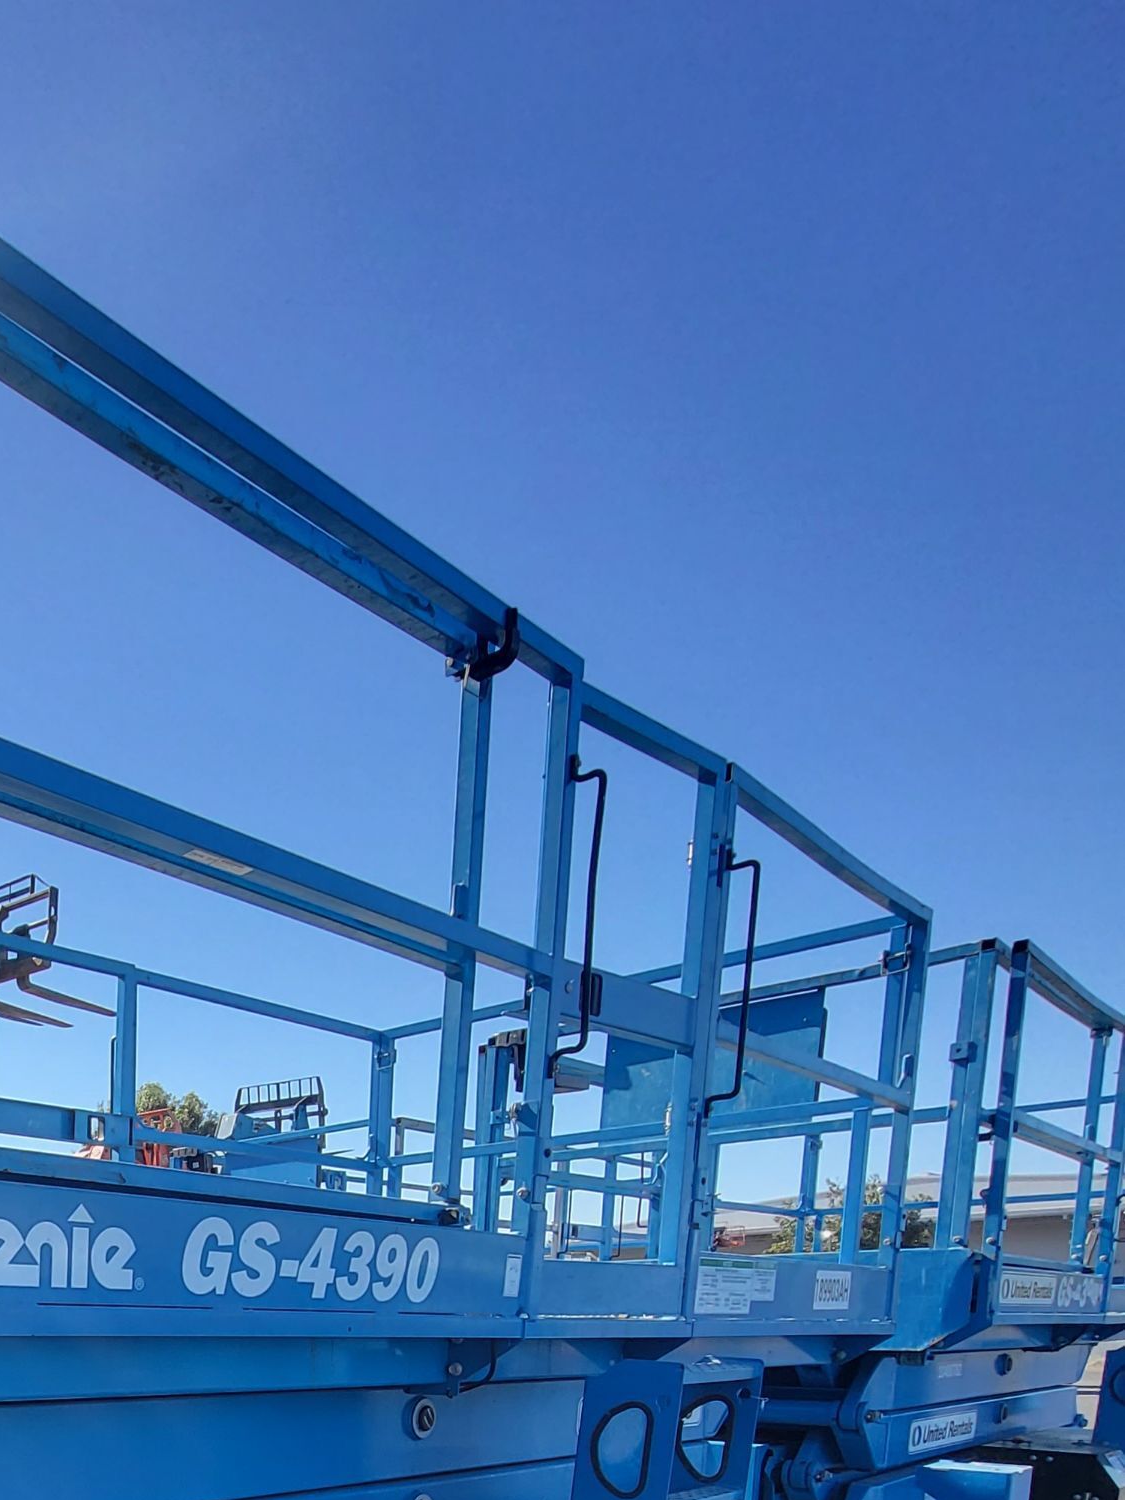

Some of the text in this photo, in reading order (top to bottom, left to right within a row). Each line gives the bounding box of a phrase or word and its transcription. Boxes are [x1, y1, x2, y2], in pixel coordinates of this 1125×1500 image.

[182, 1216, 439, 1303] GS-4390
[1010, 1279, 1033, 1299] United
[923, 1418, 974, 1443] United Rentals
